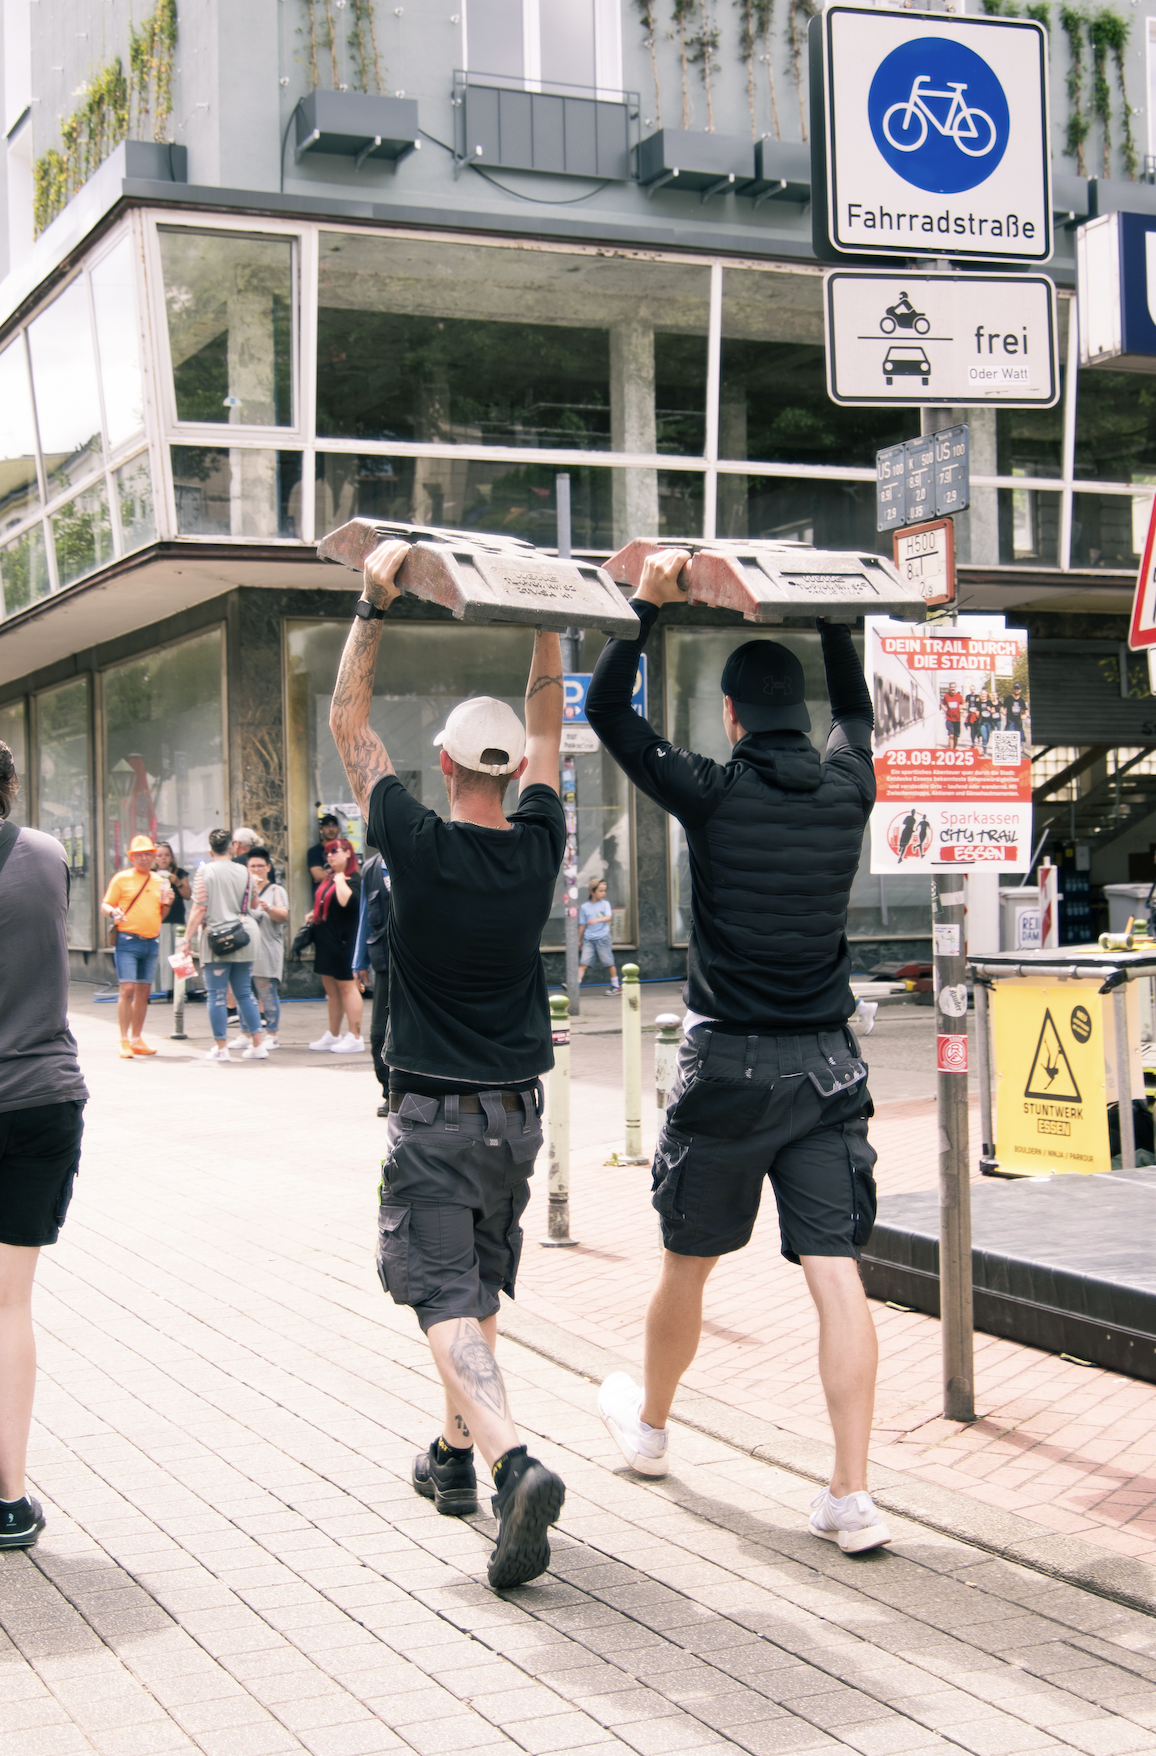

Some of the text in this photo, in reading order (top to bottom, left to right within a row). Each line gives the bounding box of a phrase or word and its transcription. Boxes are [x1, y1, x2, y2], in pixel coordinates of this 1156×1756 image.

[847, 203, 1035, 239] Fahrradstraße
[975, 325, 1029, 355] frei
[969, 368, 1028, 379] Oder Watt
[908, 452, 934, 470] K 500
[936, 442, 951, 462] US
[952, 443, 965, 457] 100
[877, 461, 904, 480] US 100
[907, 532, 935, 555] H500
[885, 638, 1016, 656] DEIN TRAIL DURCH
[914, 654, 991, 670] DIE STADT!
[887, 751, 974, 766] 28.09.2025
[940, 811, 1020, 827] Sparkassen
[1023, 1102, 1084, 1120] STUNTWERK
[1038, 1119, 1070, 1136] ESSEN
[1014, 1145, 1042, 1155] BOULDERN
[1047, 1150, 1064, 1158] NINJA
[1069, 1152, 1094, 1163] PARKOUR
